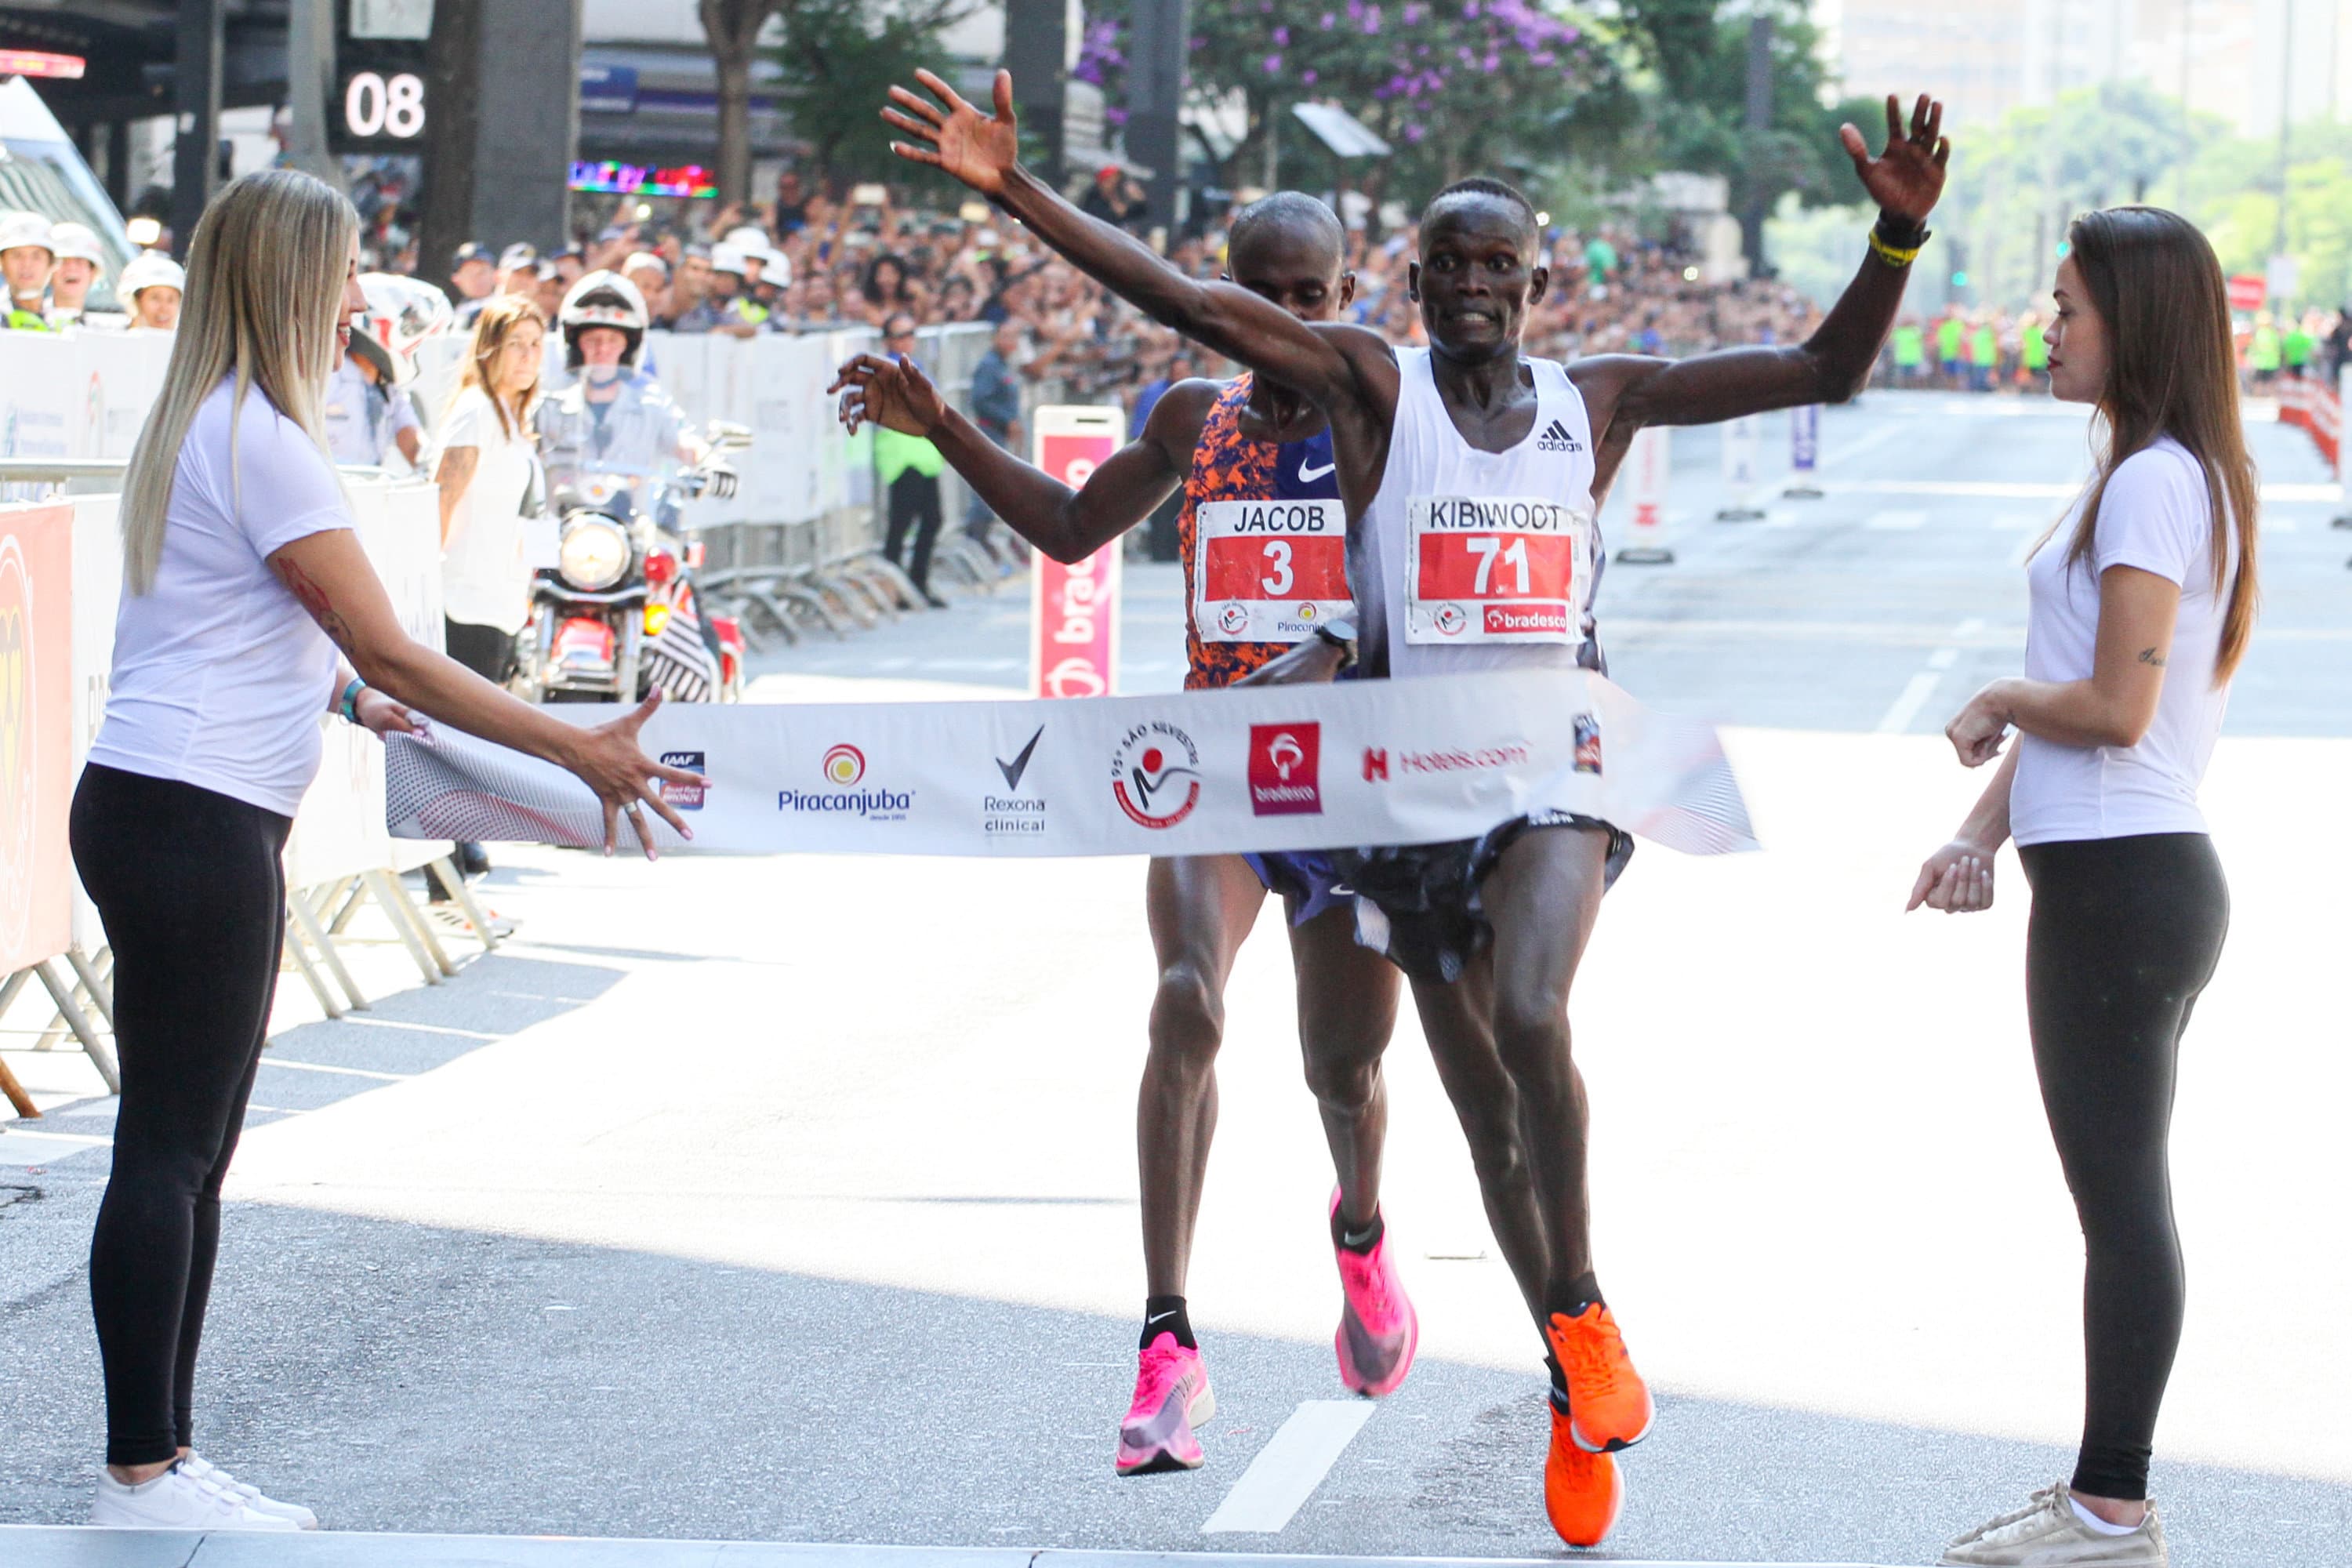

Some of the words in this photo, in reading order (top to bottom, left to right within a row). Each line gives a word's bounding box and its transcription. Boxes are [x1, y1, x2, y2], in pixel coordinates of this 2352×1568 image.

[346, 71, 426, 138] 08
[1537, 438, 1582, 452] adidas
[1234, 506, 1325, 532] JACOB
[1261, 539, 1294, 596] 3
[1467, 537, 1530, 594] 71
[1504, 613, 1566, 628] bradesco
[663, 754, 695, 767] IAAF
[779, 788, 910, 816] Piracanjuba
[985, 795, 1045, 811] Rexona
[985, 818, 1045, 831] clinical
